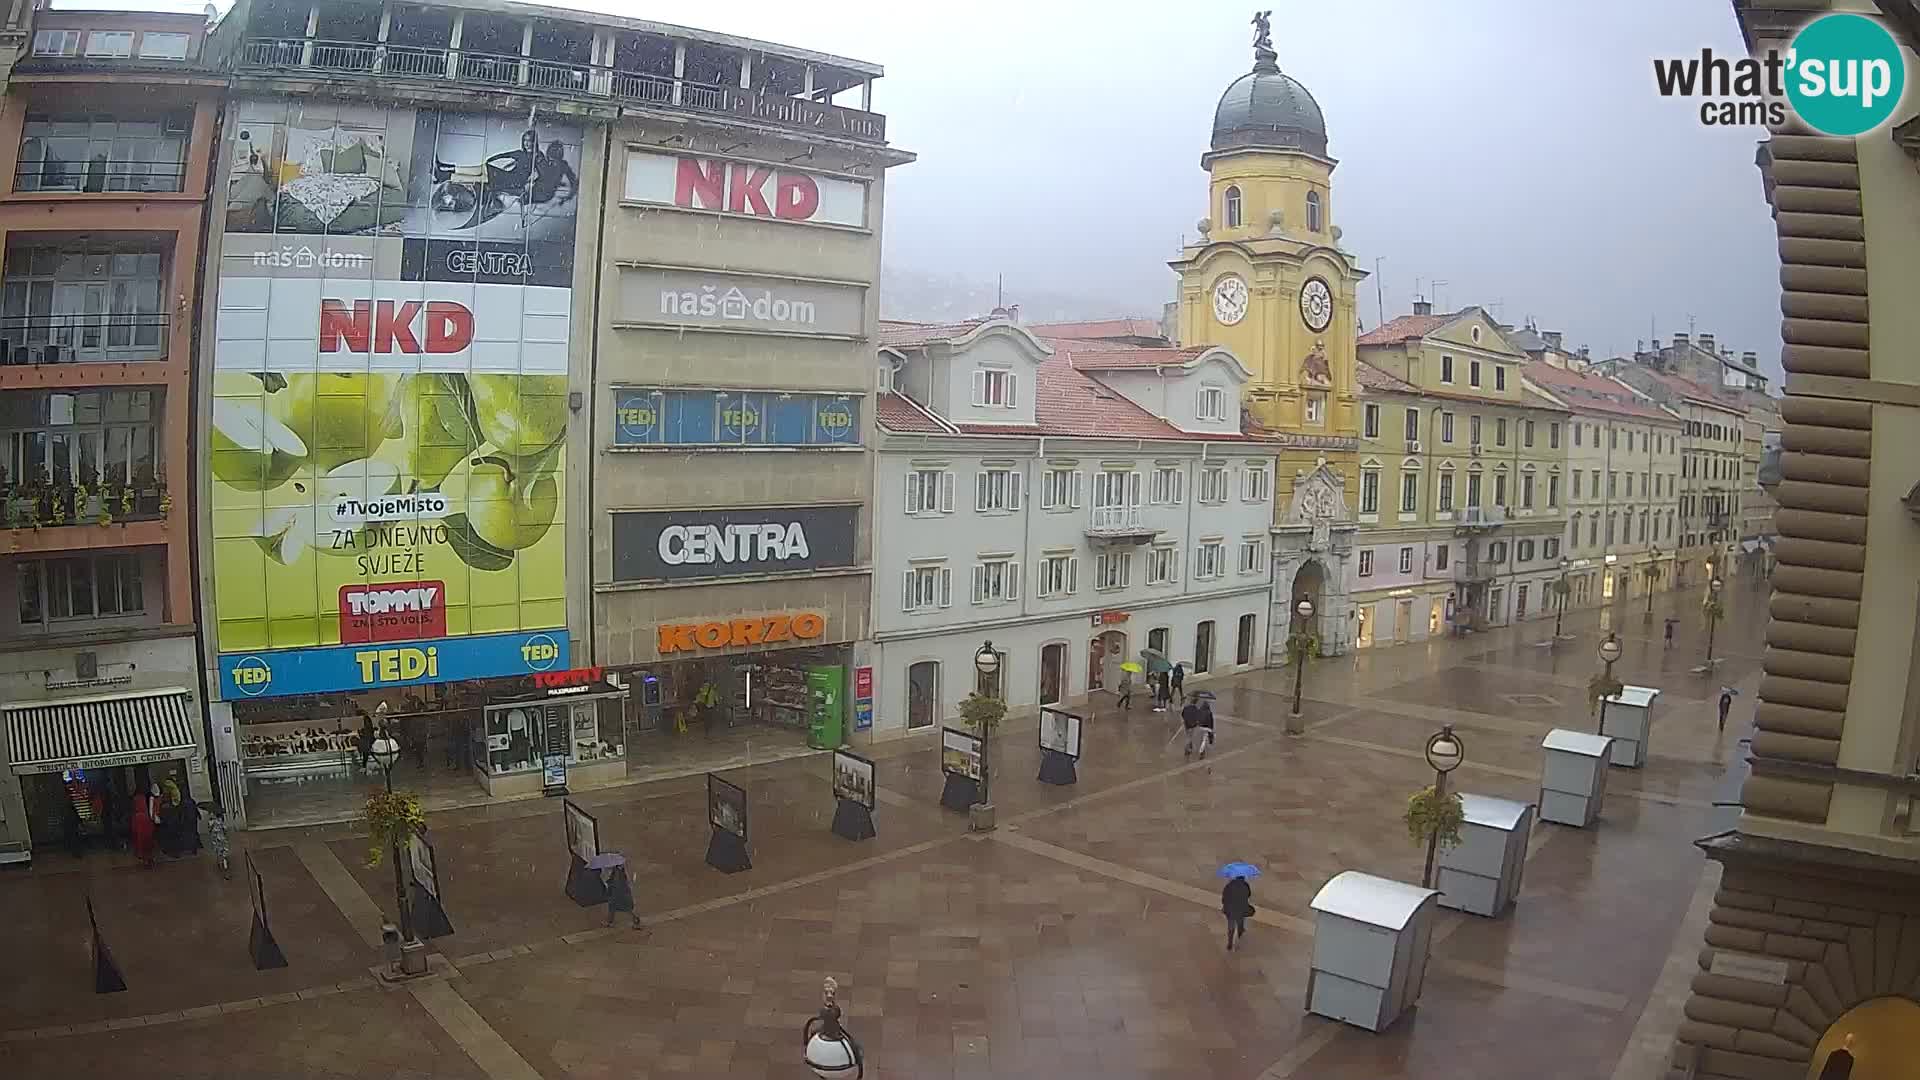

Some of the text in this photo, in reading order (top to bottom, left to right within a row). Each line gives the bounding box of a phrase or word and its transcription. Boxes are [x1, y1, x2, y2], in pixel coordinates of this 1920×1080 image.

[674, 158, 820, 222] NKD
[253, 246, 364, 269] naš dom
[446, 250, 534, 276] CENTRA
[659, 285, 816, 324] naš dom
[319, 298, 476, 354] NKD
[617, 407, 657, 426] TEDi
[722, 410, 760, 427] TEDi
[818, 411, 853, 427] TEDi
[336, 497, 445, 517] #TvojeMisto
[331, 524, 449, 550] ZA DNEVNO
[657, 521, 810, 565] CENTRA
[357, 548, 425, 576] SVJEŽE
[346, 587, 438, 616] TOMMY
[657, 612, 826, 654] KORZO
[355, 647, 439, 684] TEDi
[521, 643, 559, 662] TEDi
[232, 667, 272, 686] TEDi
